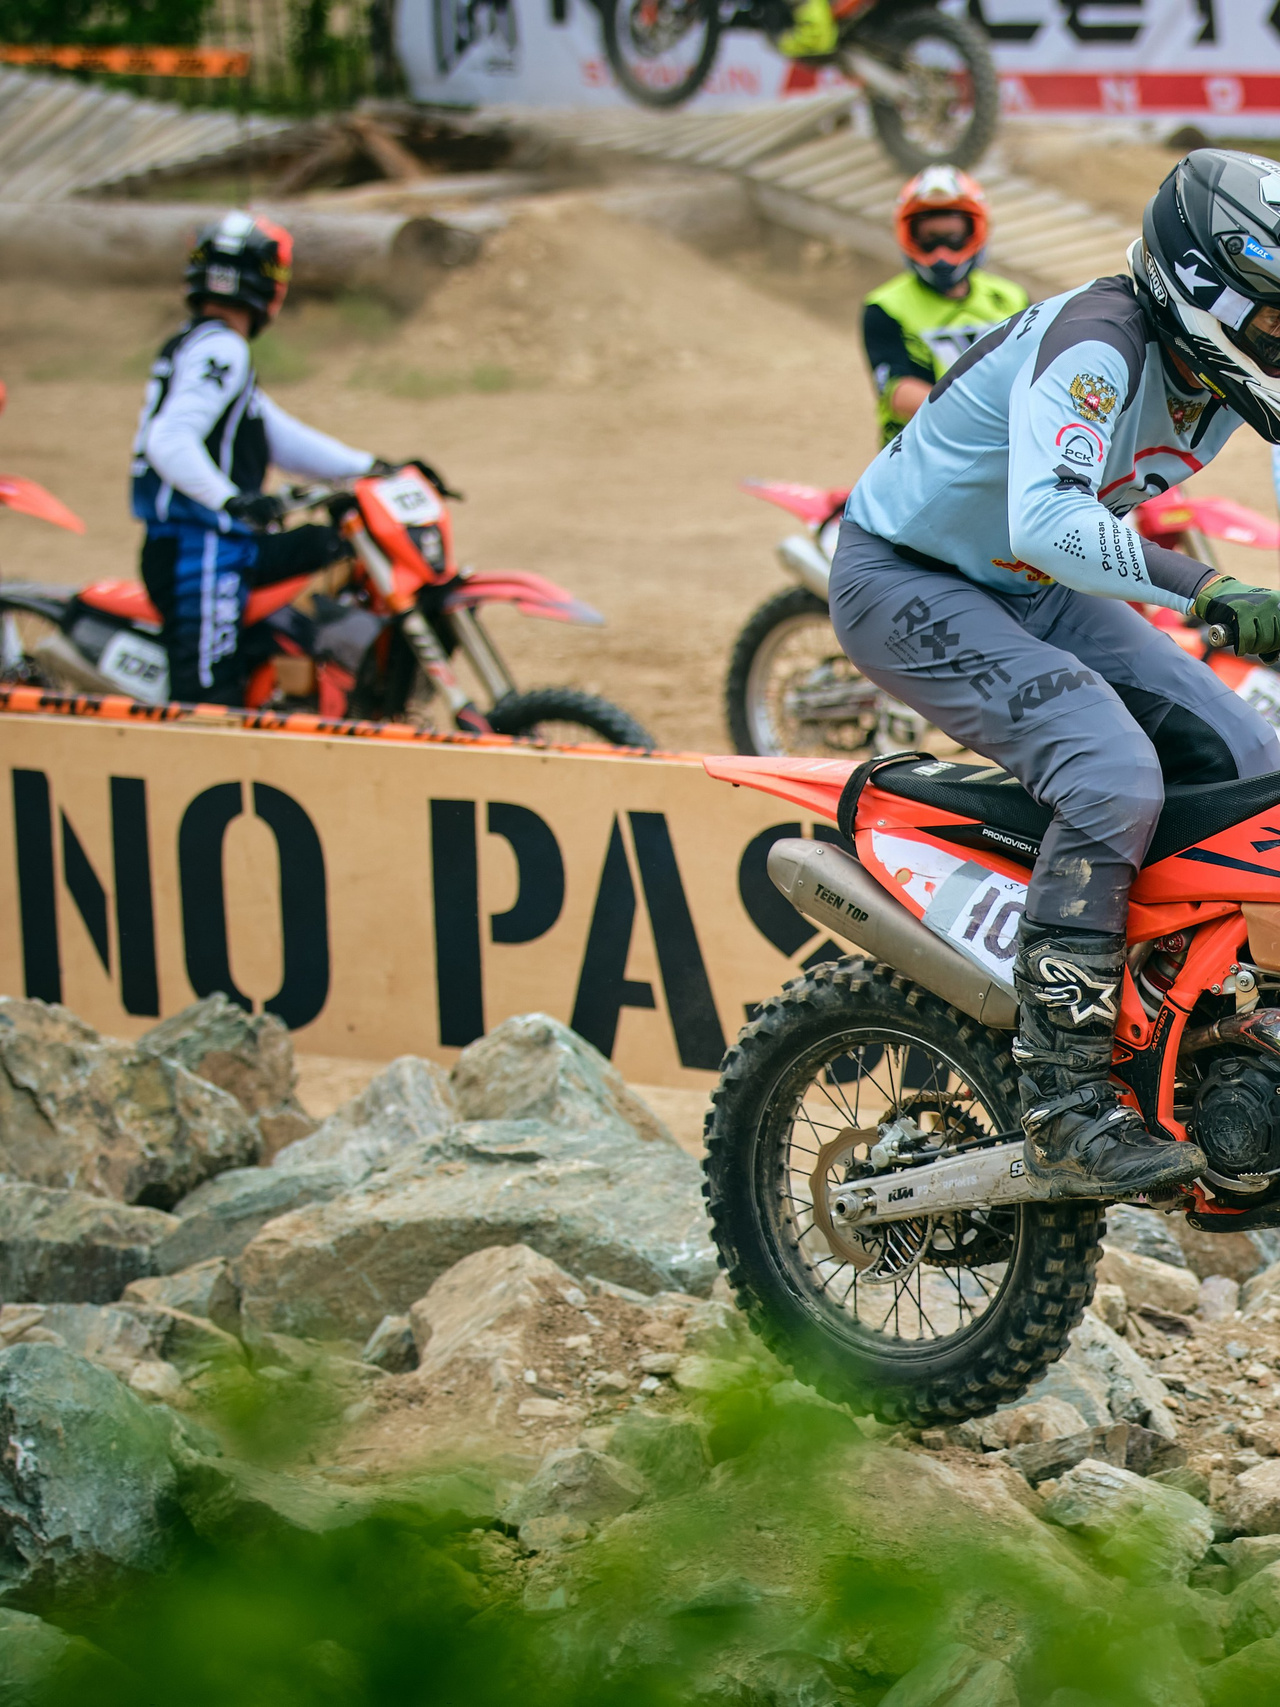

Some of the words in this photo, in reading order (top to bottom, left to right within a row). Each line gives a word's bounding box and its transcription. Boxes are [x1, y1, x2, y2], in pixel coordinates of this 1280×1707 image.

[1145, 257, 1167, 301] SHOEI
[1064, 447, 1092, 464] РСК
[1098, 521, 1113, 572] Русская
[1008, 667, 1098, 724] KTM
[982, 828, 1032, 853] PRONOVICH
[12, 768, 330, 1031] NO
[815, 883, 845, 910] TEEN
[845, 902, 869, 922] TOP
[962, 885, 1026, 961] 10
[1151, 1009, 1169, 1051] ACERBIS
[887, 1185, 914, 1203] KTM
